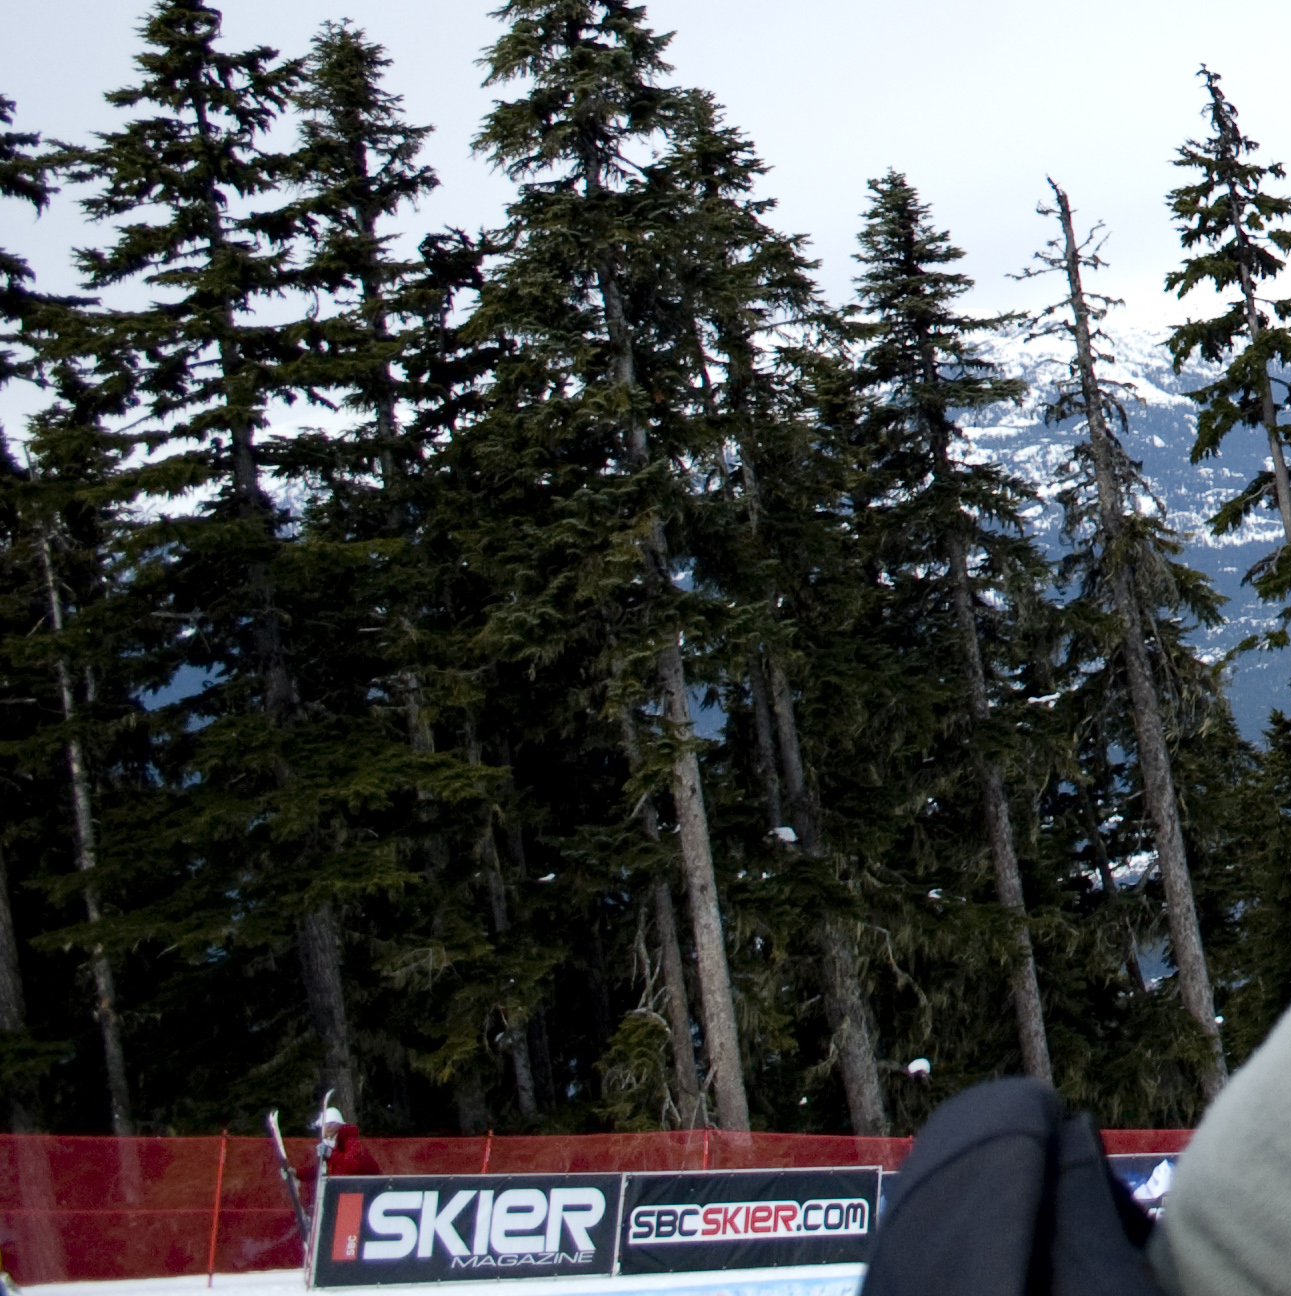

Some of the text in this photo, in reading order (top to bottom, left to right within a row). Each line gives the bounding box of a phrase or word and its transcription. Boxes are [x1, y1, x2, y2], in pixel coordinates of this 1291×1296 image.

[362, 1187, 606, 1260] SKIER
[632, 1203, 868, 1239] SBCSKIER.COM
[451, 1250, 596, 1269] MAGAZINE
